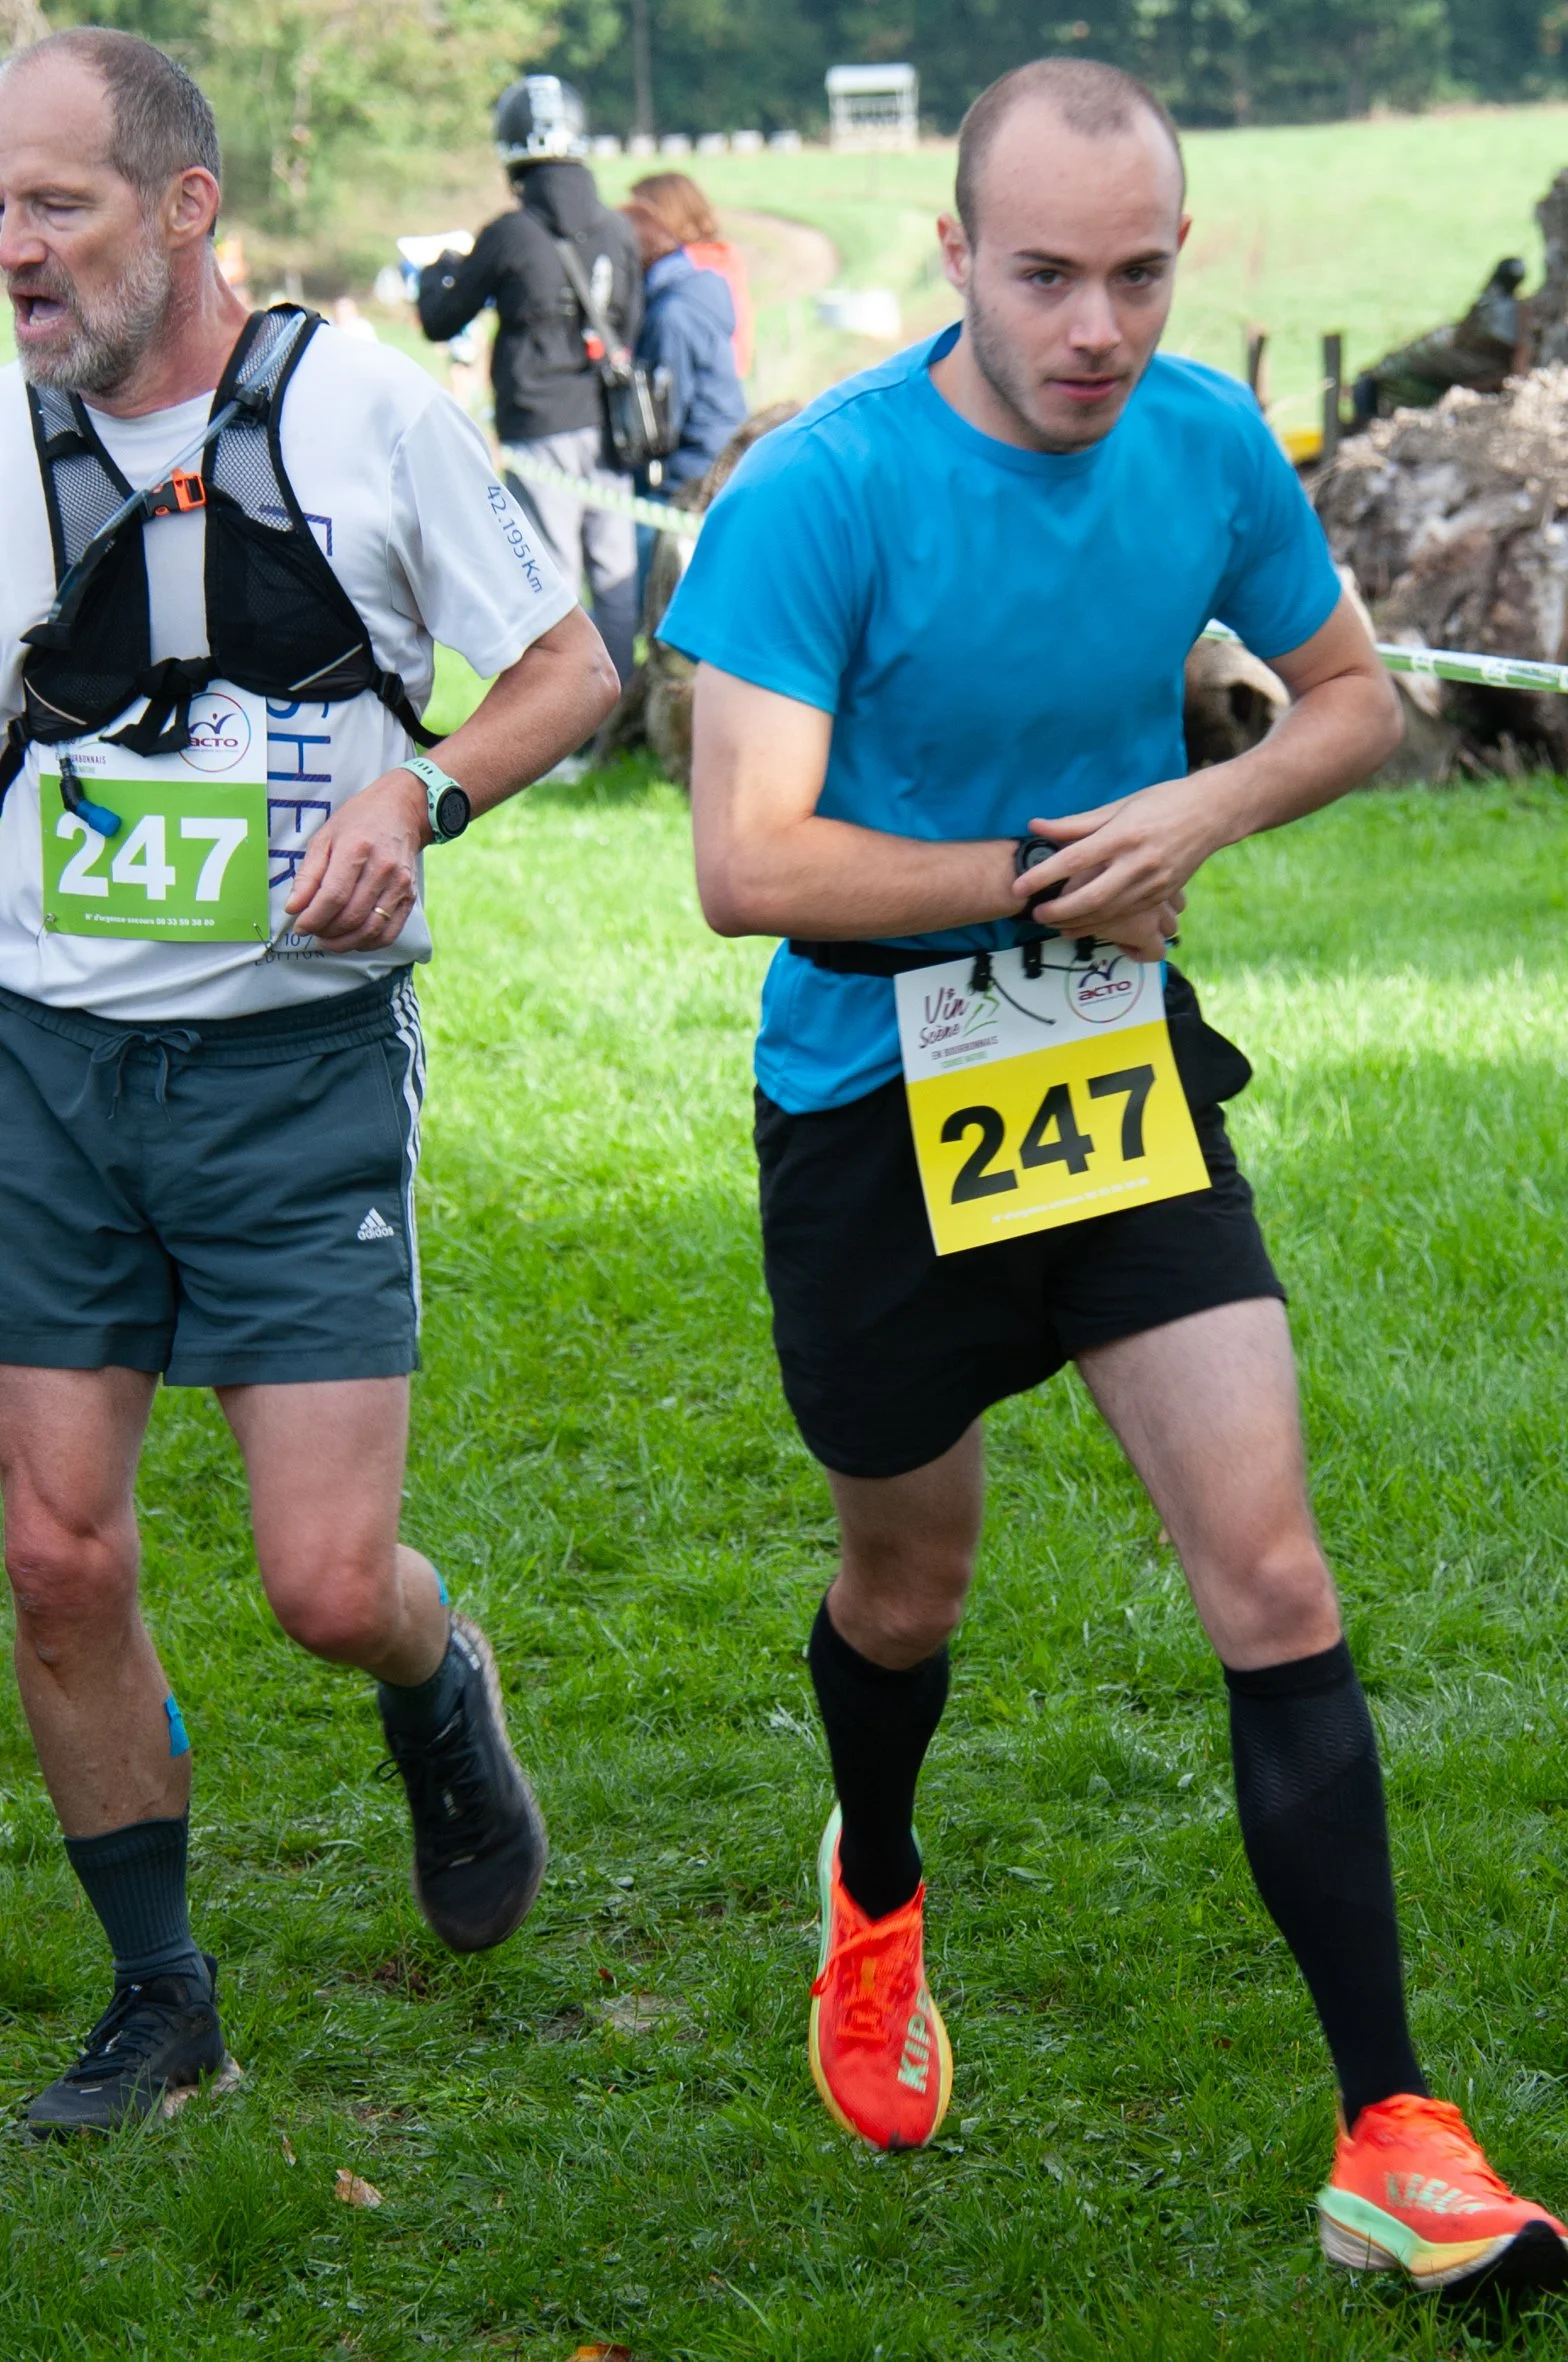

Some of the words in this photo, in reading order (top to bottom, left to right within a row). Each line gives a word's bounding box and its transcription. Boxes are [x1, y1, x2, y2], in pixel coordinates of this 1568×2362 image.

[487, 485, 531, 559] 42.195
[56, 814, 248, 902] 247
[940, 1063, 1156, 1206] 247
[356, 1225, 395, 1241] adidas
